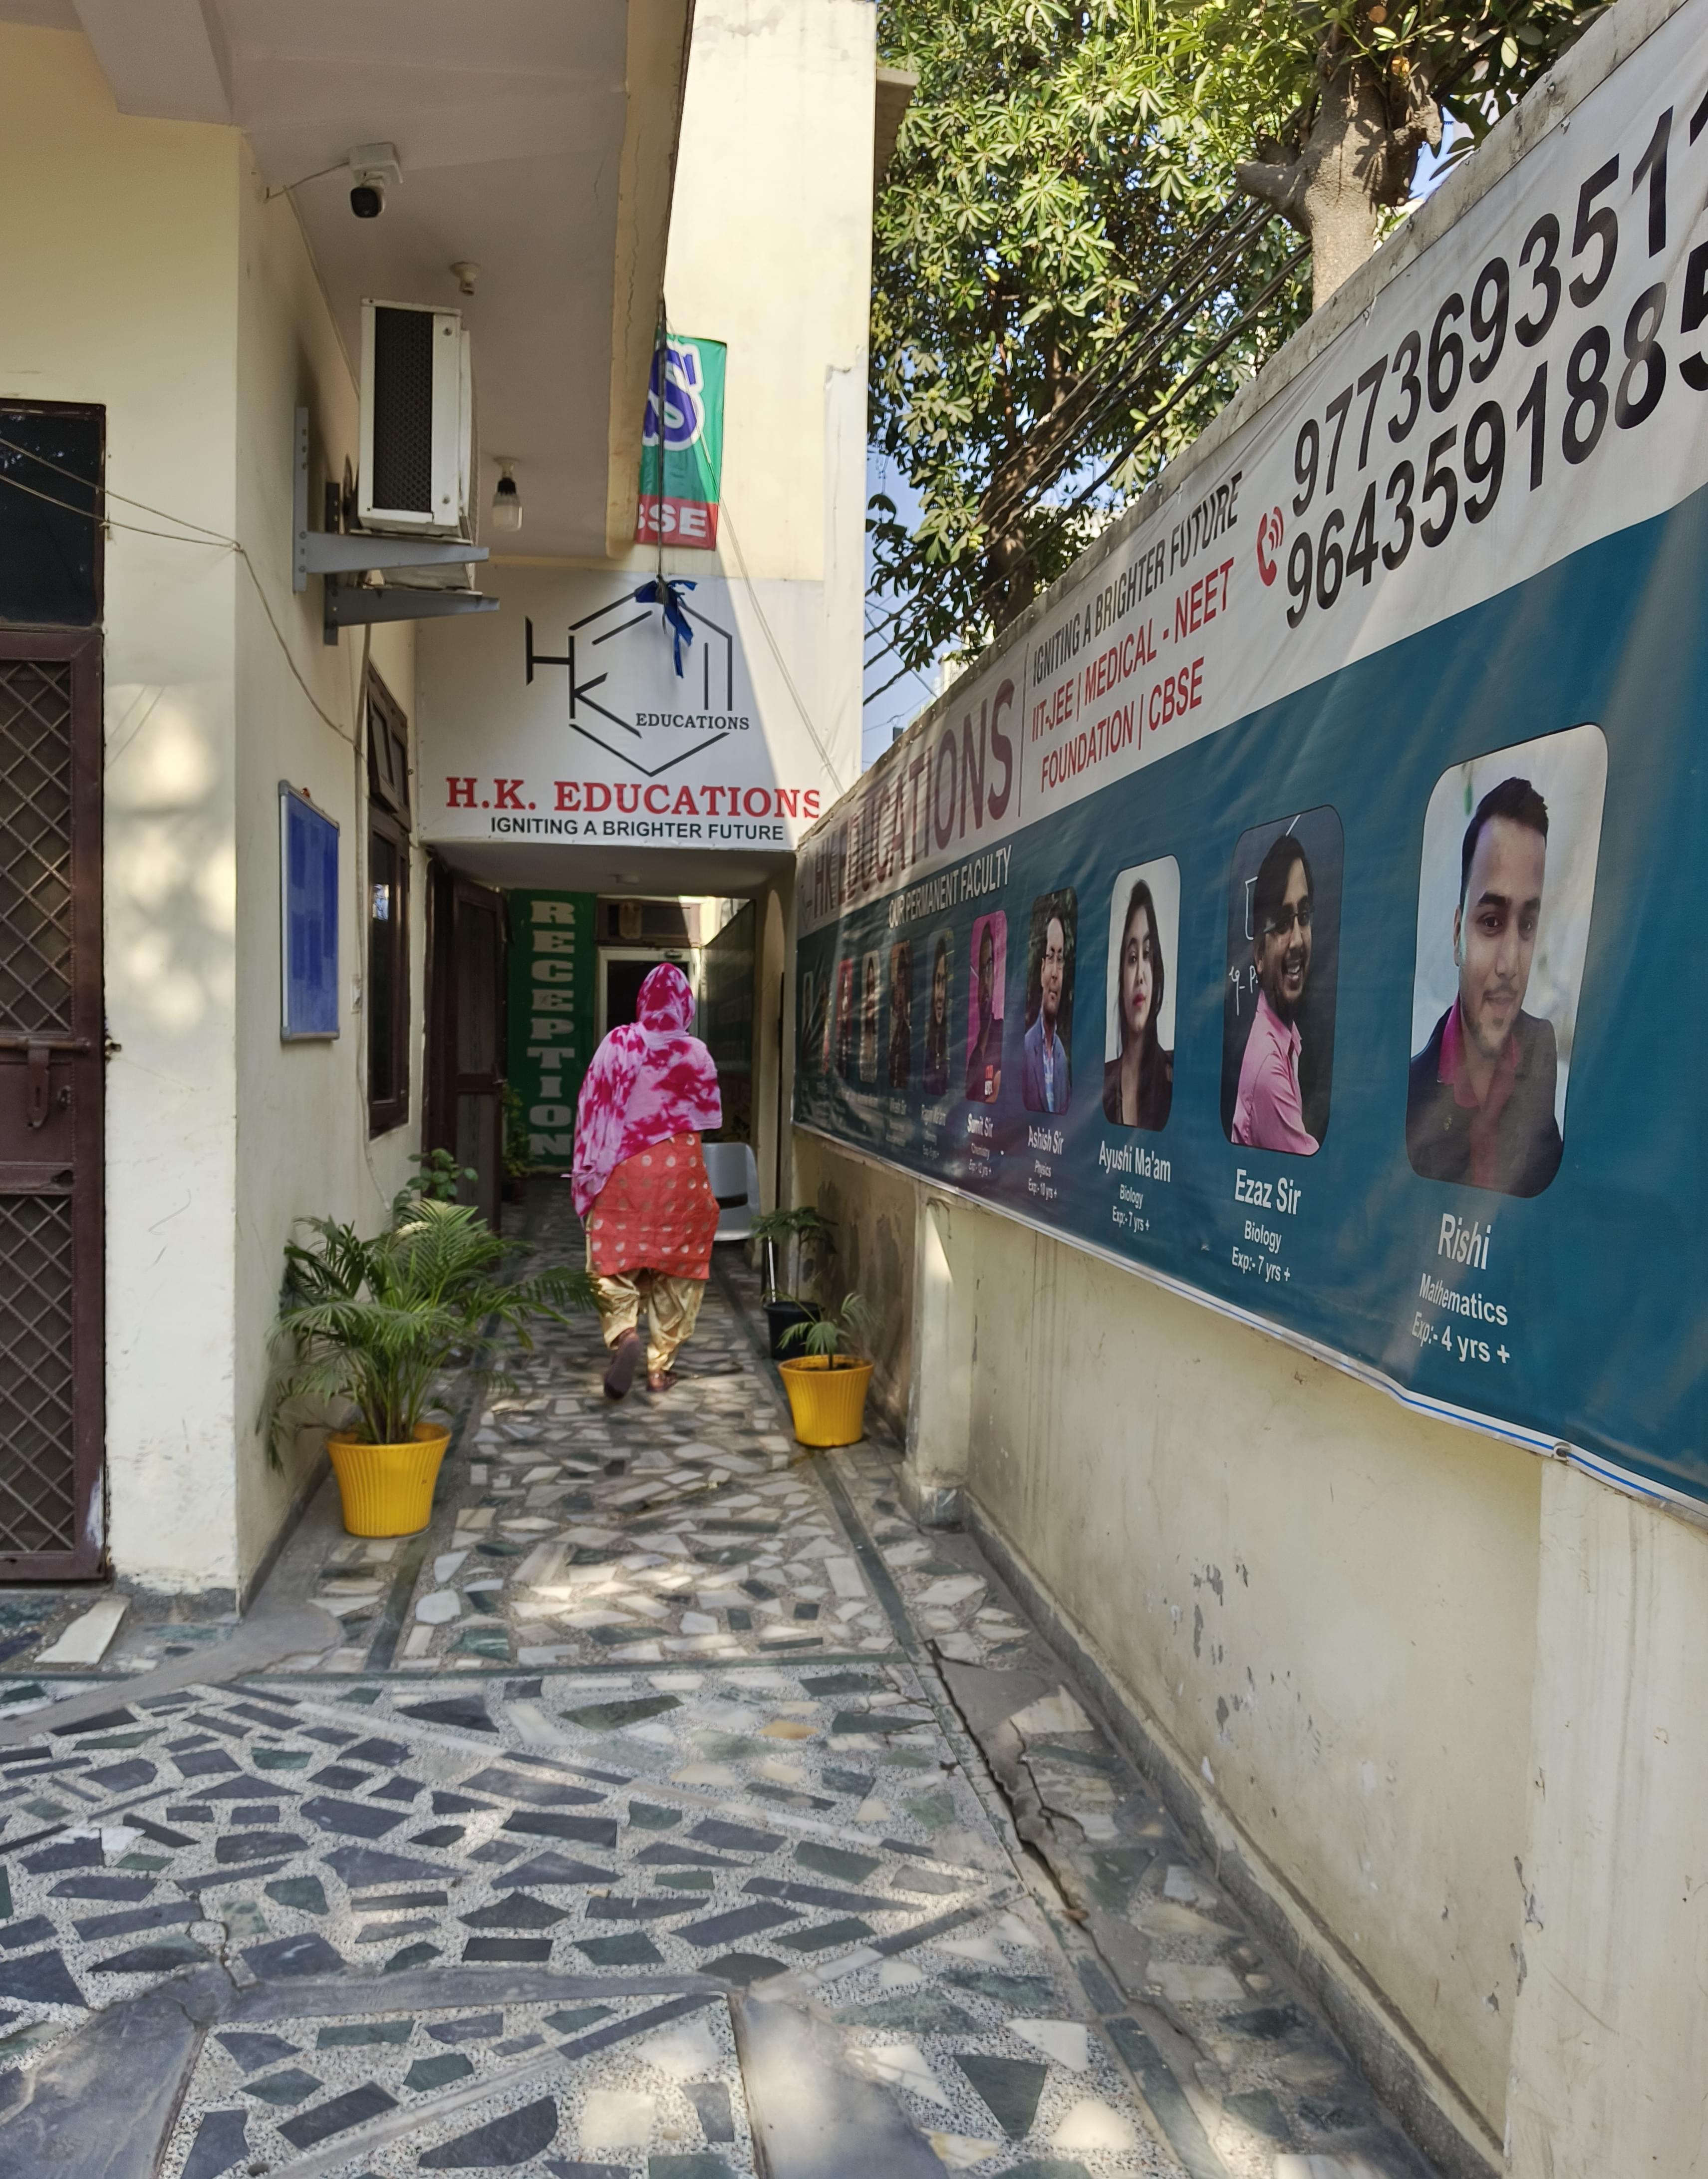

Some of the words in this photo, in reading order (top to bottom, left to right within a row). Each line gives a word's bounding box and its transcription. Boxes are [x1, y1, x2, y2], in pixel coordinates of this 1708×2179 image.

[1292, 89, 1708, 517] 977369351
[1033, 629, 1080, 688] IGNITING
[1083, 611, 1091, 648] A
[1095, 538, 1165, 638] BRIGHTER
[1169, 471, 1242, 576] FUTURE
[1032, 678, 1074, 742] IIT-JEE
[1085, 618, 1157, 706] MEDICAL
[1174, 556, 1234, 644] NEET
[636, 713, 750, 731] EDUCATIONS
[1041, 700, 1135, 793] FOUNDATION
[1149, 656, 1204, 731] CBSE
[446, 777, 536, 811] H.K.
[555, 781, 820, 818] EDUCATIONS
[491, 817, 578, 835] IGNITING
[583, 820, 597, 835] A
[603, 821, 702, 838] BRIGHTER
[709, 824, 784, 840] FUTURE
[905, 869, 959, 922] PERMANENT
[960, 844, 1012, 902] FACULTY
[527, 901, 576, 1156] RECEPTION
[984, 1117, 993, 1138] Sir
[1028, 1125, 1052, 1152] Ashish
[1053, 1130, 1064, 1155] Sir
[1099, 1140, 1133, 1174] Ayushi
[1135, 1147, 1171, 1183] Ma'am
[1120, 1184, 1143, 1210] Biology
[1235, 1168, 1272, 1209] Ezaz
[1276, 1177, 1302, 1215] Sir
[1129, 1211, 1133, 1228] 7
[1134, 1217, 1144, 1233] yrs
[1244, 1220, 1282, 1254] Biology
[1437, 1213, 1492, 1270] Rishi
[1232, 1246, 1256, 1274] Exp:-
[1258, 1255, 1265, 1275] 7
[1265, 1262, 1281, 1283] yrs
[1284, 1267, 1291, 1282] +
[1419, 1273, 1508, 1326] Mathematics
[1412, 1311, 1438, 1347] Exp:-
[1441, 1325, 1452, 1352] 4
[1457, 1336, 1490, 1362] yrs
[1497, 1344, 1510, 1364] +
